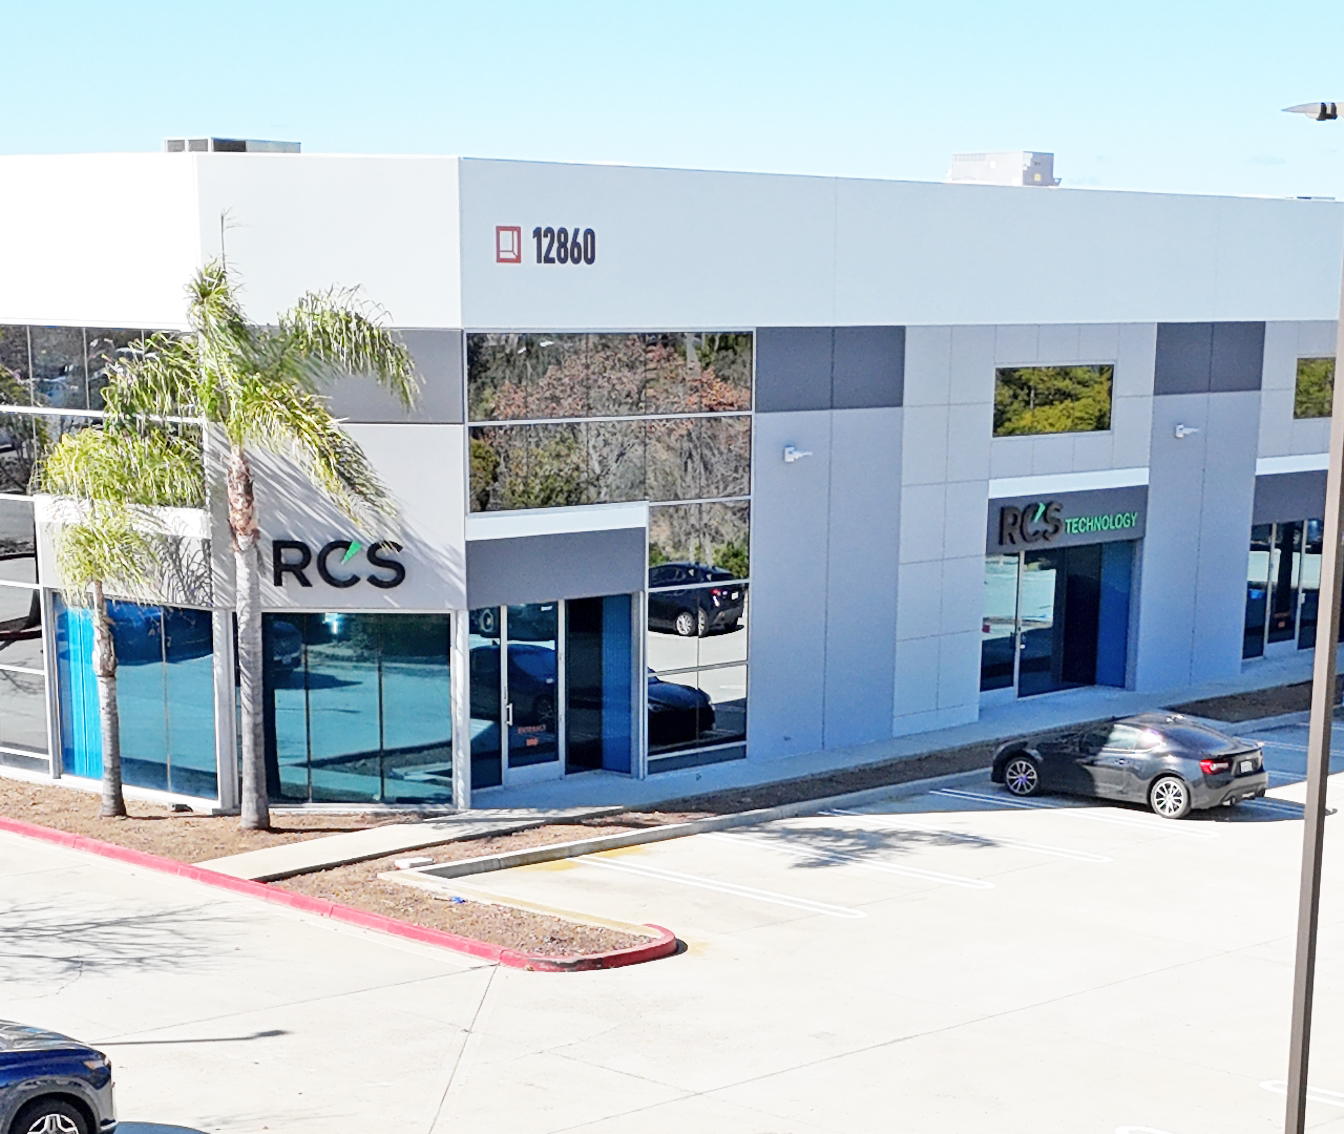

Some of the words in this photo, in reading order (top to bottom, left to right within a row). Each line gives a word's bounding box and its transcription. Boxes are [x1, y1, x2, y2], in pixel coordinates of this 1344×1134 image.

[532, 226, 596, 265] 12860
[999, 500, 1064, 545] RCS
[1065, 511, 1138, 534] TECHNOLOGY
[272, 540, 406, 589] RCS
